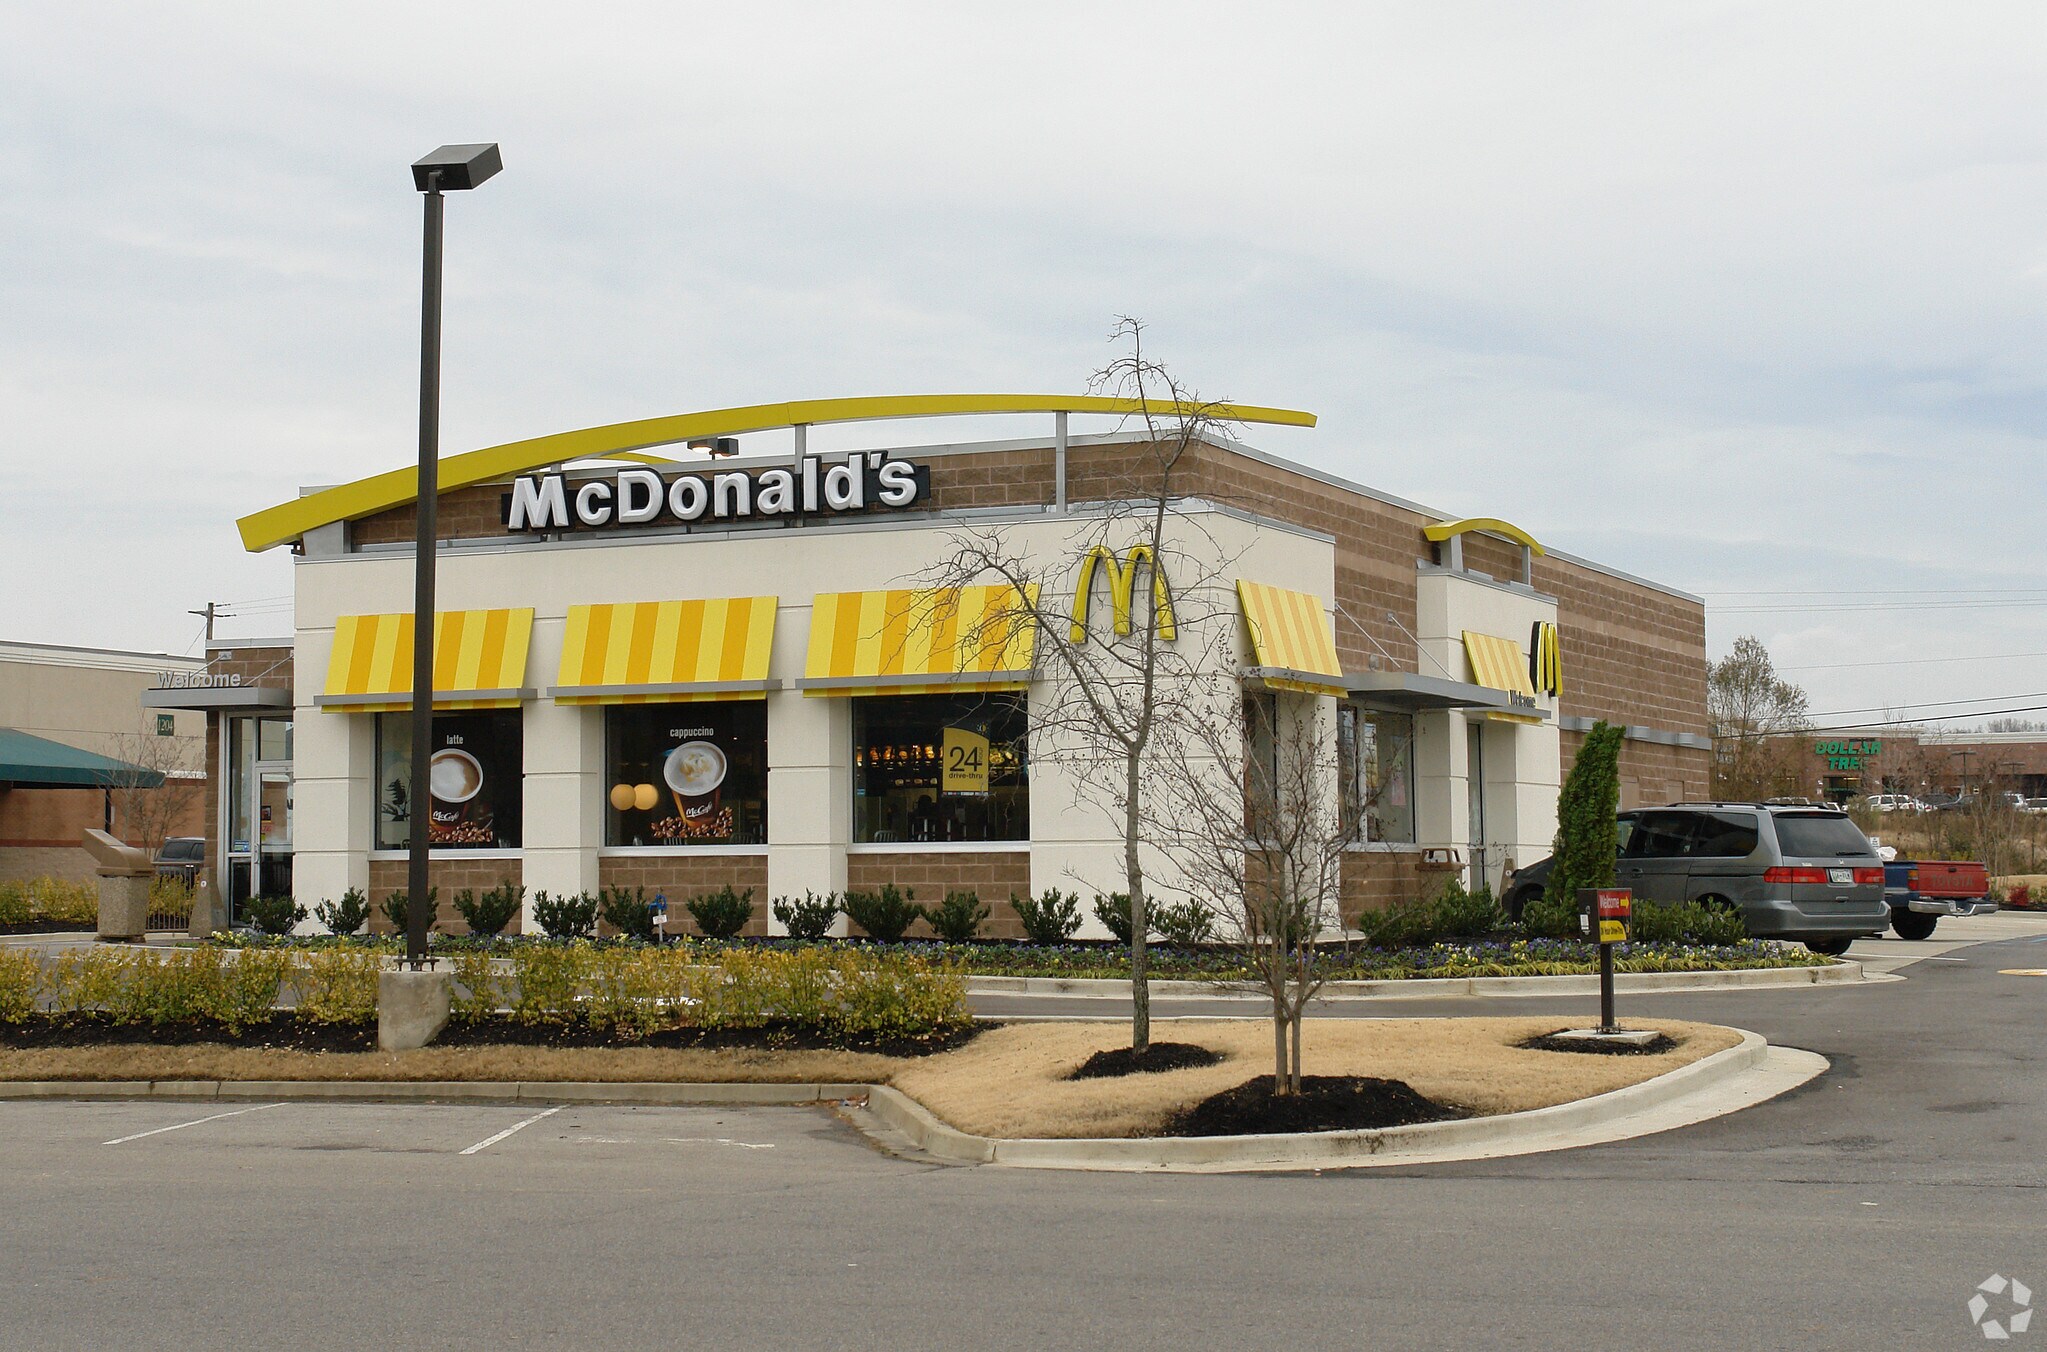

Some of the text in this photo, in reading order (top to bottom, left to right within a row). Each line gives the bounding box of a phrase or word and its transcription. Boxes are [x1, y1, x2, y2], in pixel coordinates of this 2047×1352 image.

[507, 451, 919, 530] McDonald's
[155, 670, 242, 689] Welcome
[157, 718, 174, 732] 1204
[446, 734, 464, 745] latte
[669, 726, 715, 740] cappuccino
[1815, 741, 1883, 755] DOLLAR
[949, 746, 983, 772] 24
[948, 772, 984, 780] drive-thru
[1931, 872, 1975, 890] TOYOTA
[1599, 894, 1620, 909] Welcome
